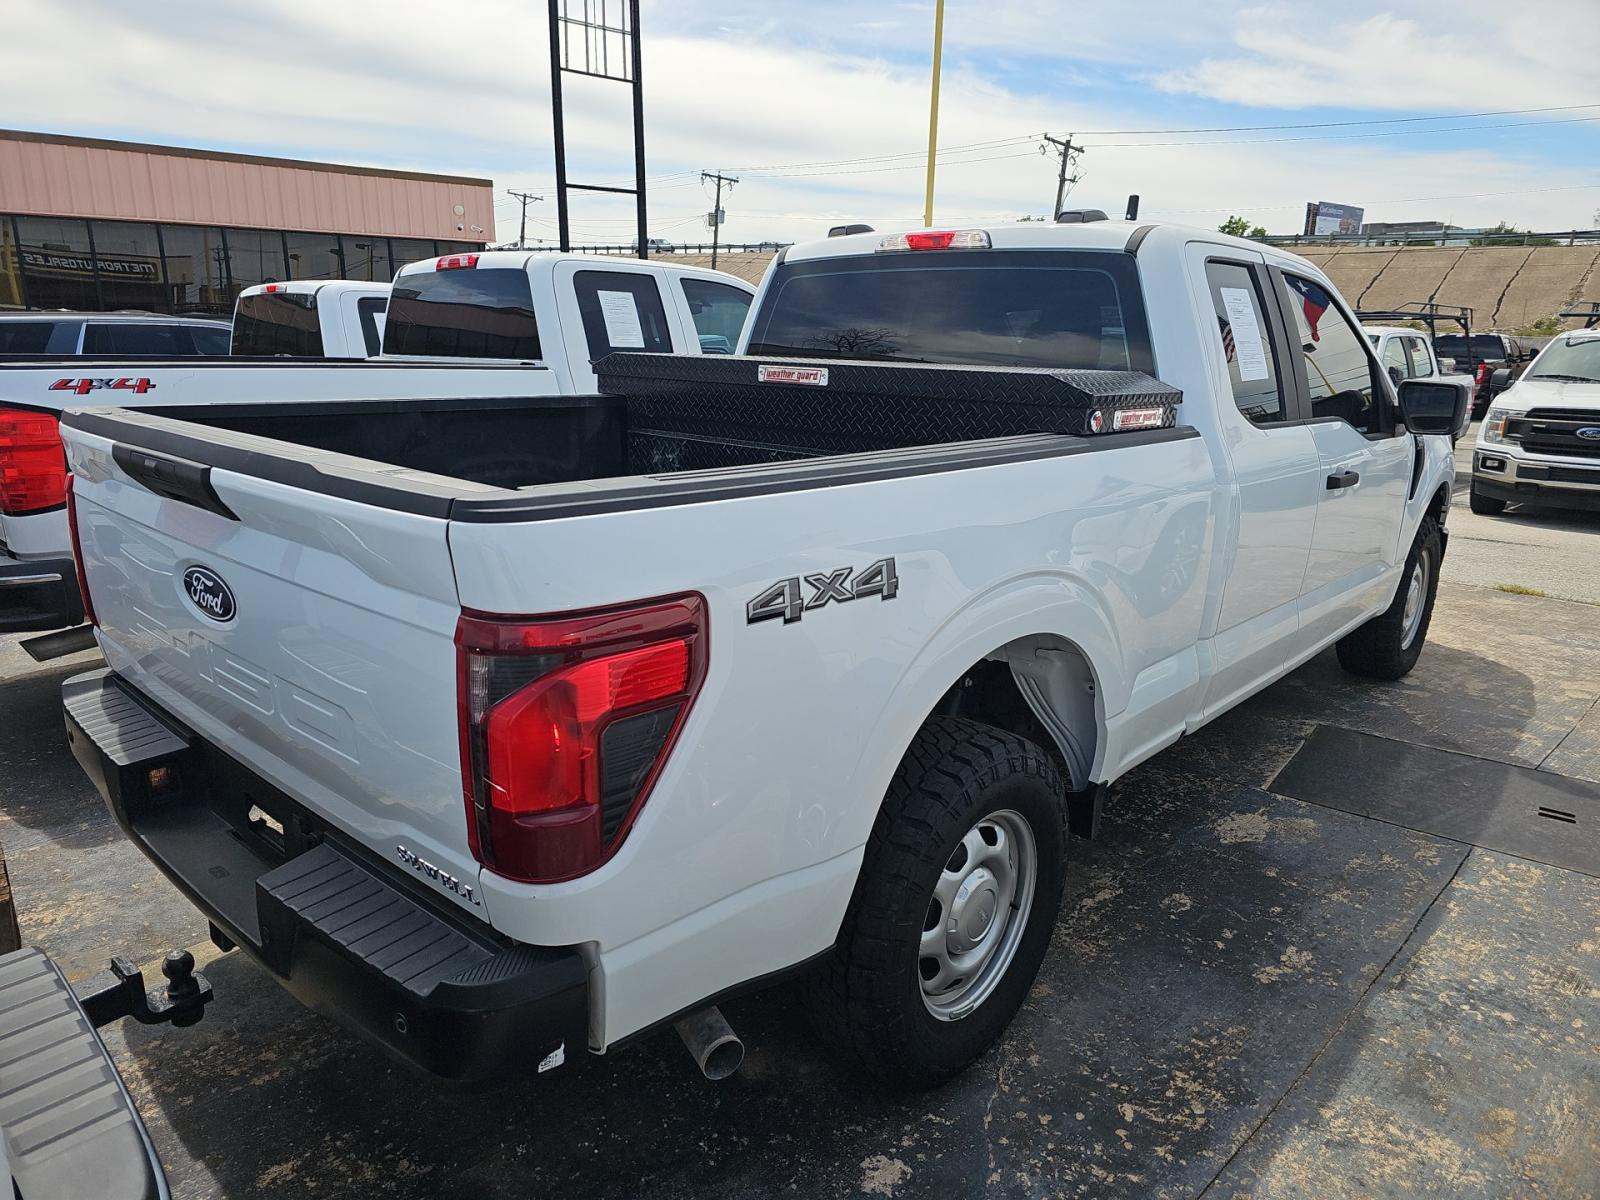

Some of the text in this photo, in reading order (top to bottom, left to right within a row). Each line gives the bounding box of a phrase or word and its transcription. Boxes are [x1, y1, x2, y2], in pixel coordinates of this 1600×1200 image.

[48, 377, 156, 395] 4x4
[766, 369, 819, 381] weather guard
[191, 573, 224, 614] Ford
[397, 844, 480, 905] SEWELL
